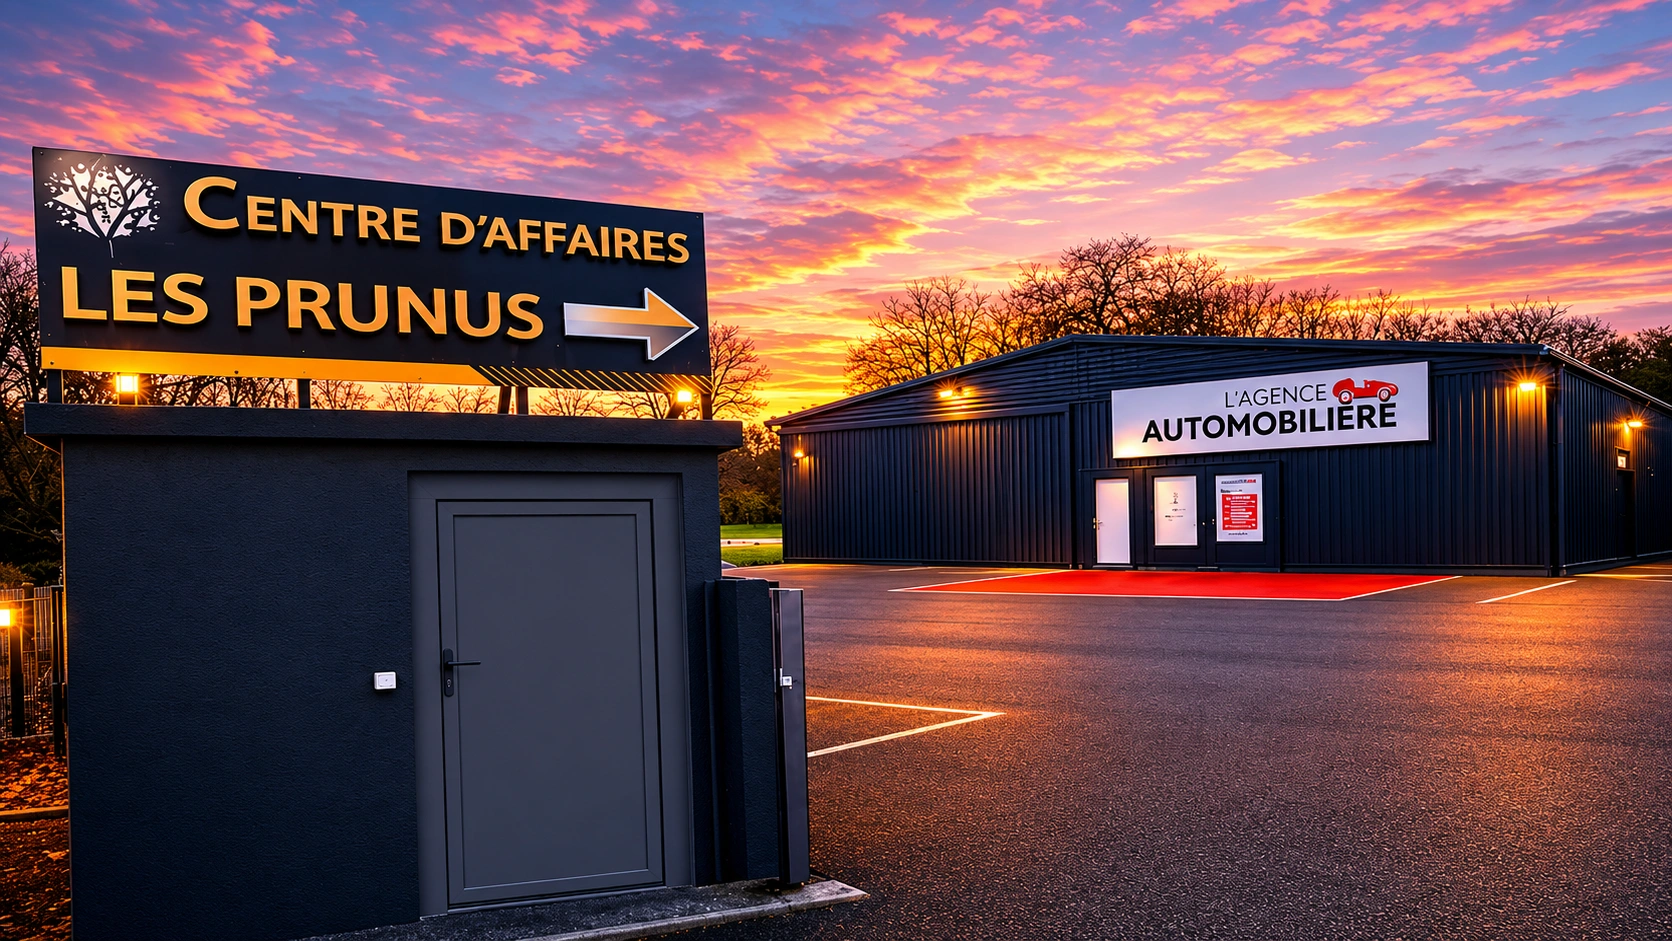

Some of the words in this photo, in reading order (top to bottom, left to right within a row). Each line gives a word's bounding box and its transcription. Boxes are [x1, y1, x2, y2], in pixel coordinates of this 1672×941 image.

[184, 176, 420, 242] CENTRE
[440, 212, 690, 264] D'AFFAIRES
[61, 266, 209, 325] LES
[235, 276, 545, 339] PRUNUS
[1225, 383, 1327, 408] L'AGENCE
